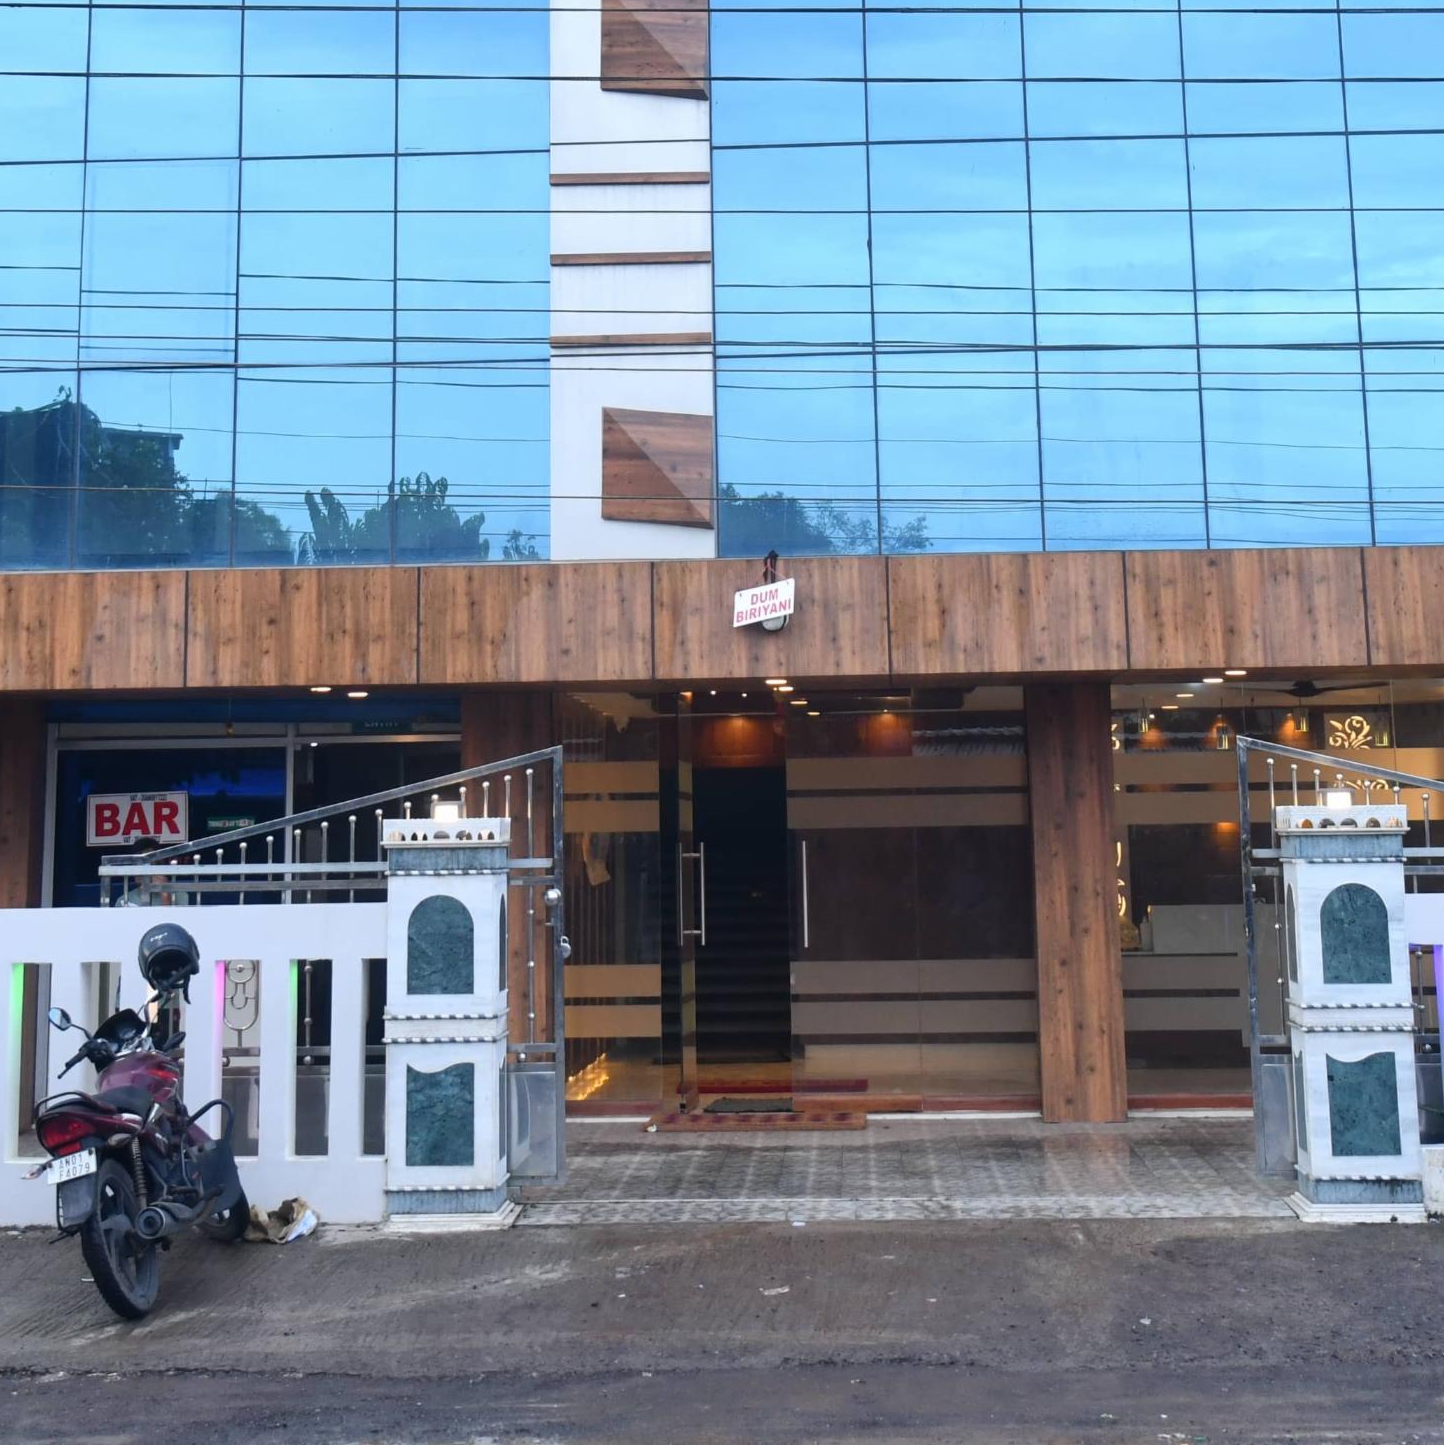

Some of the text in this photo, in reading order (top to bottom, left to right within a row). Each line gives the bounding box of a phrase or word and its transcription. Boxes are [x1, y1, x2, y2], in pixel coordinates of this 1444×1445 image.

[751, 588, 779, 606] DUM
[736, 598, 791, 623] BIRIYANI
[95, 800, 180, 837] BAR
